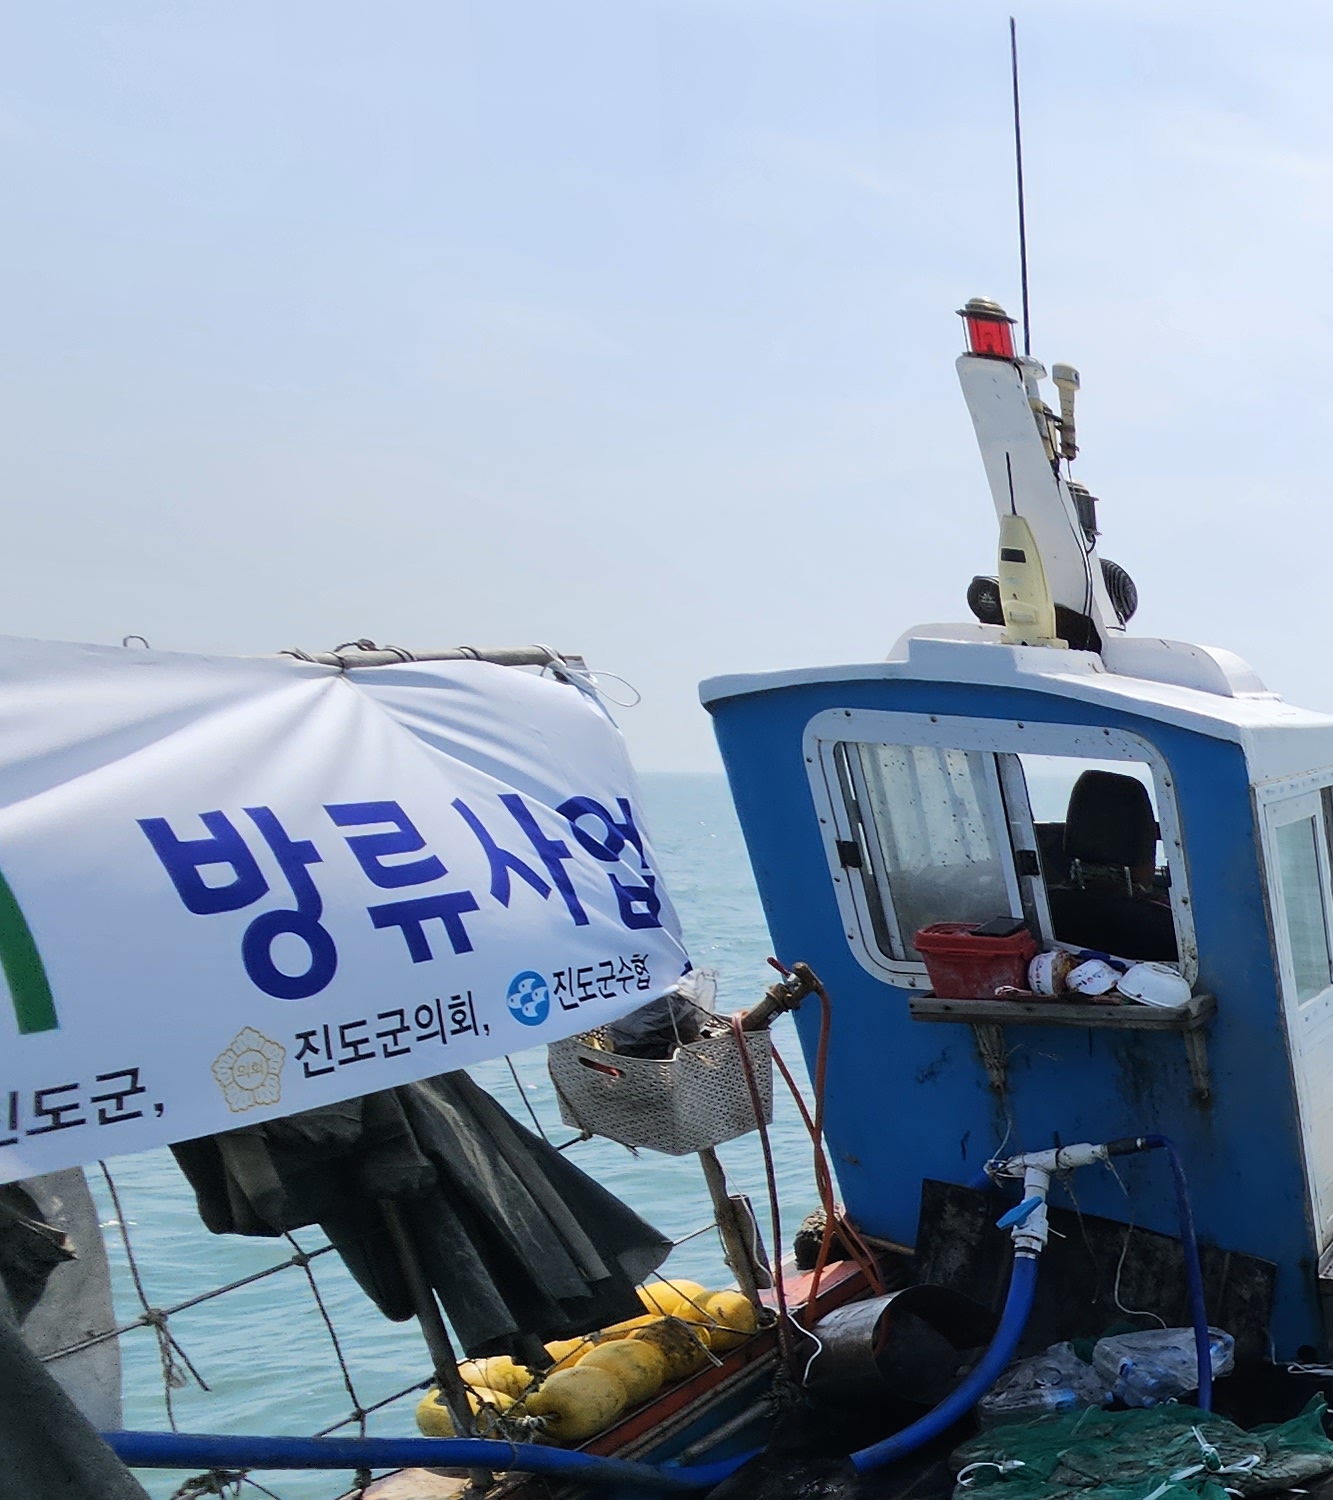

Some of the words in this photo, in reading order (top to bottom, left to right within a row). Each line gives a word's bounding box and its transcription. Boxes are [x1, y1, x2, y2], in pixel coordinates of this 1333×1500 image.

[135, 793, 662, 1000] 방류사업
[294, 990, 491, 1079] 진도군의회,
[552, 953, 651, 1011] 진도군수협
